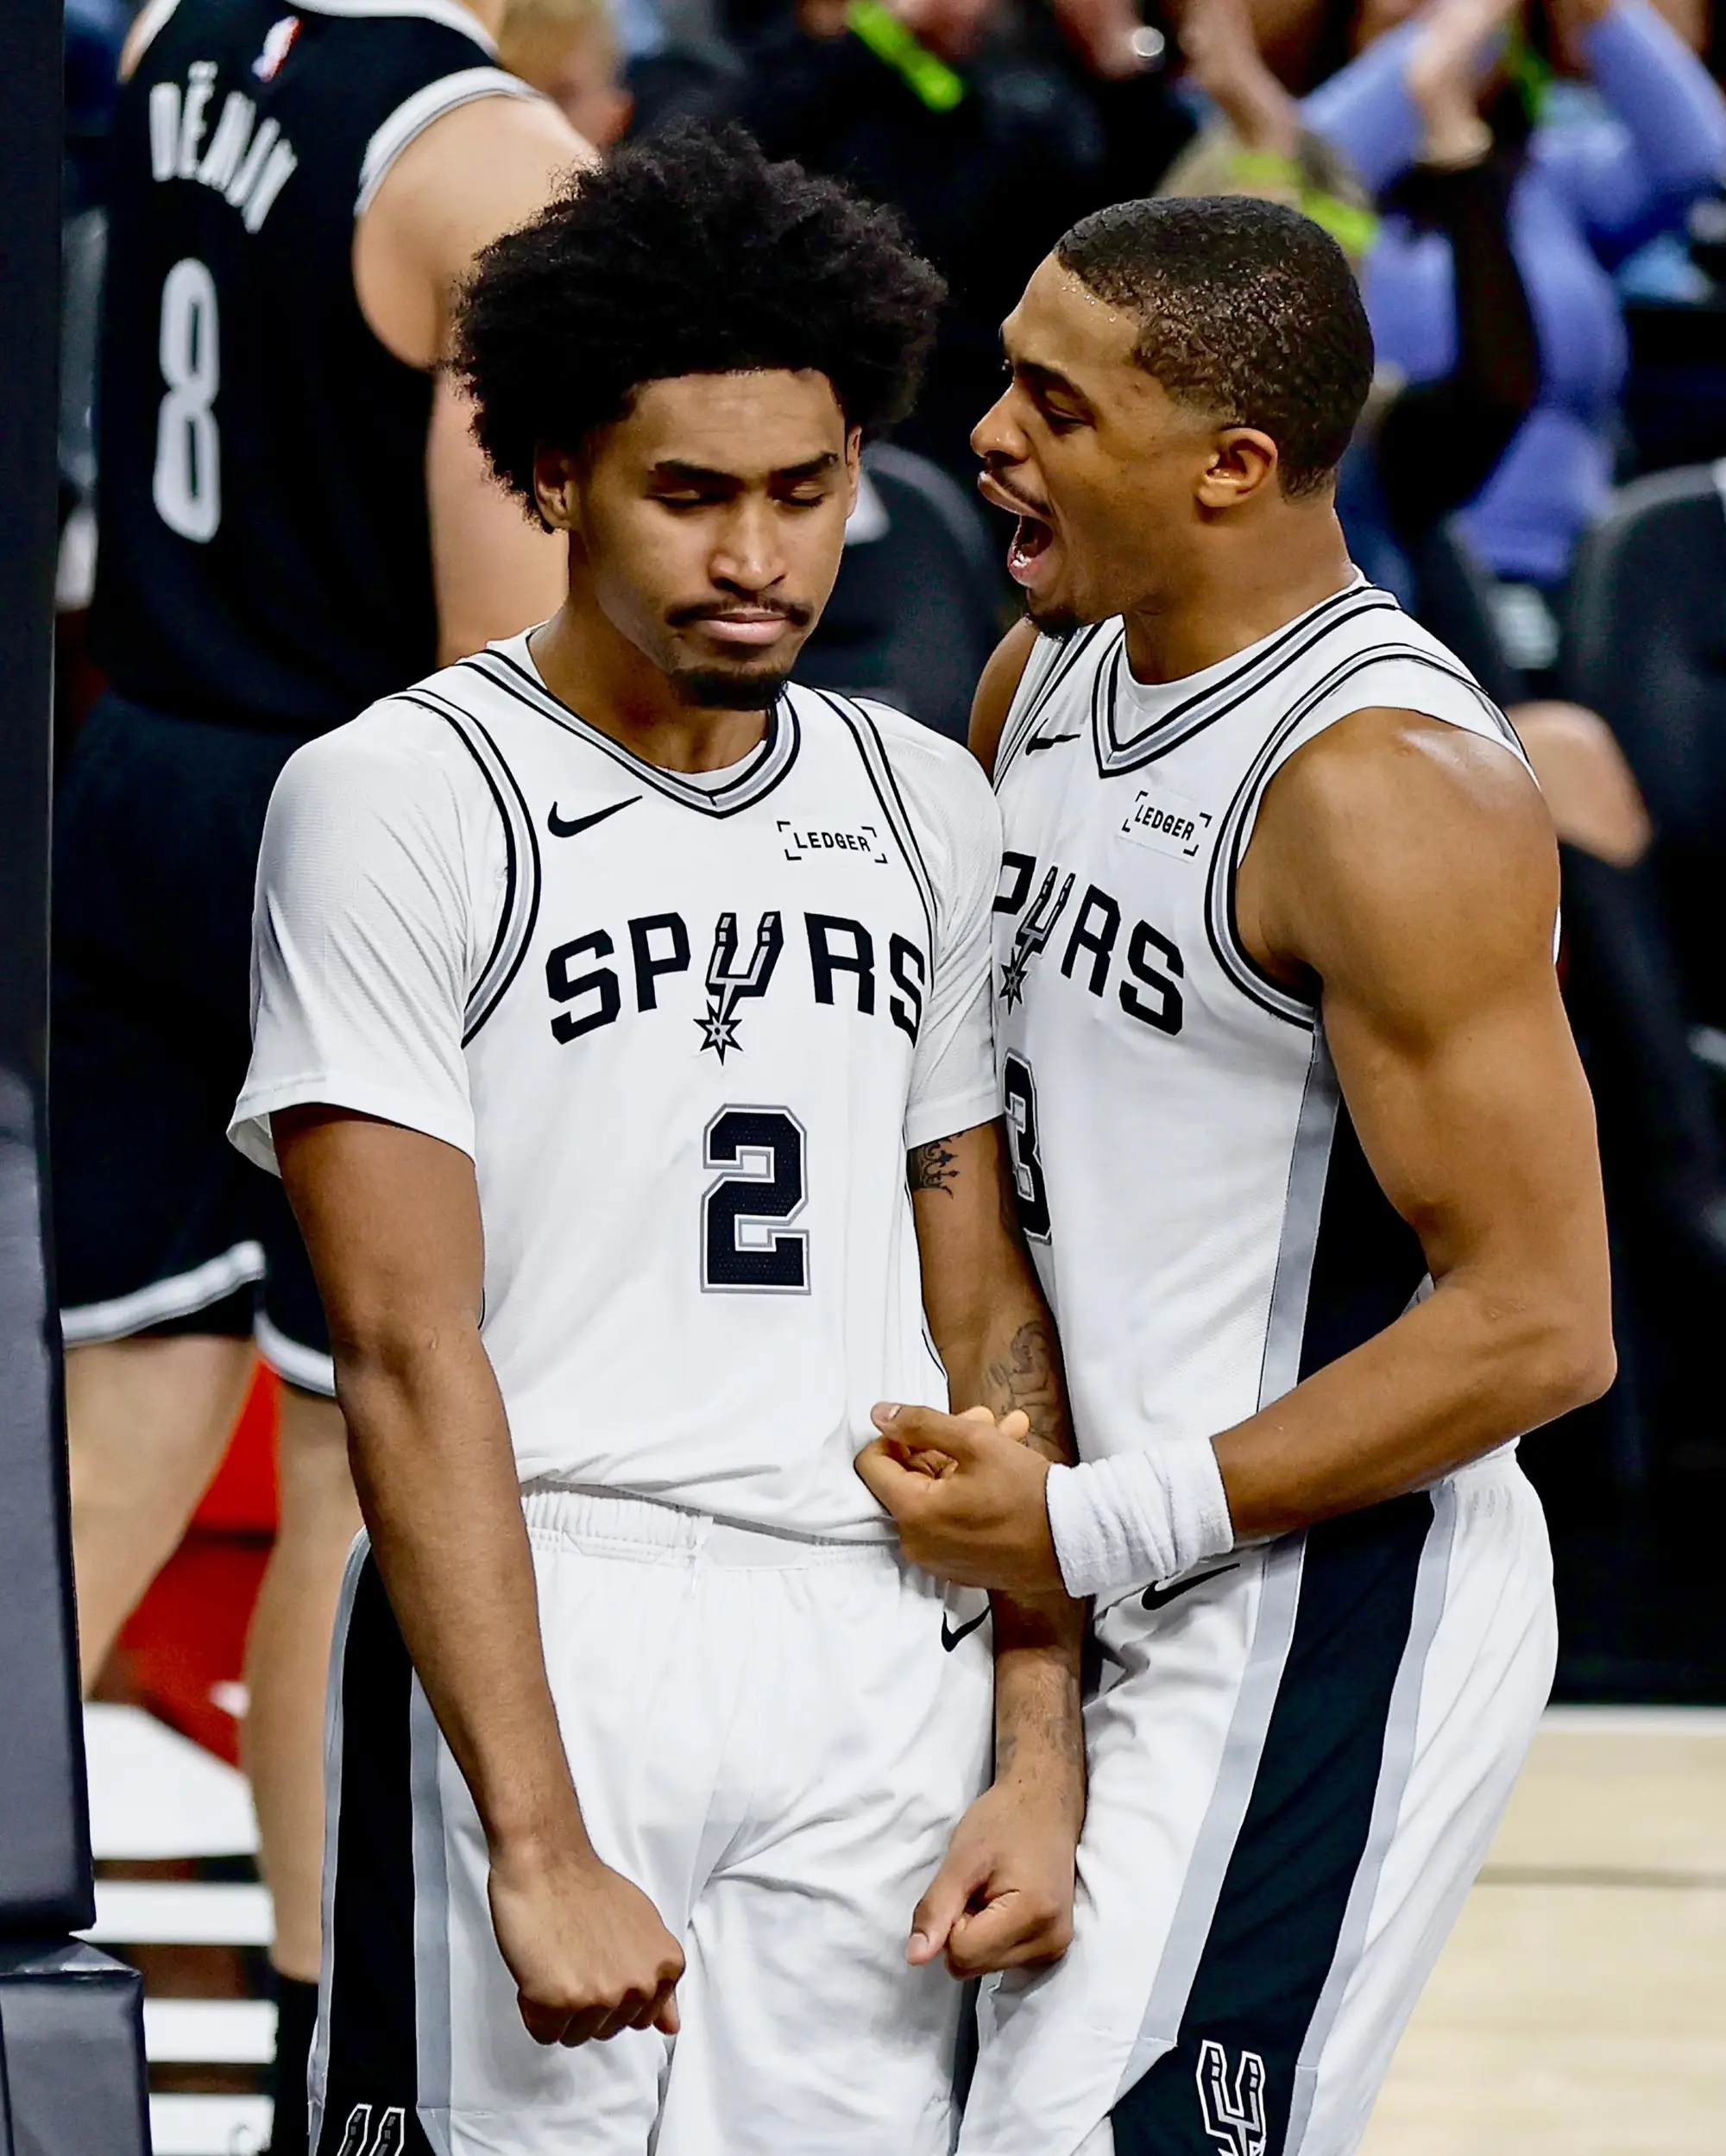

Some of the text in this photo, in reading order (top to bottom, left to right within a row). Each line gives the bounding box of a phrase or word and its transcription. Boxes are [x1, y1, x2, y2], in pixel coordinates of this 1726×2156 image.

[153, 257, 221, 543] 8
[794, 831, 872, 853] LEDGER
[1134, 804, 1195, 842] LEDGER
[545, 911, 927, 1066] SPURS
[700, 1102, 811, 1295] 2
